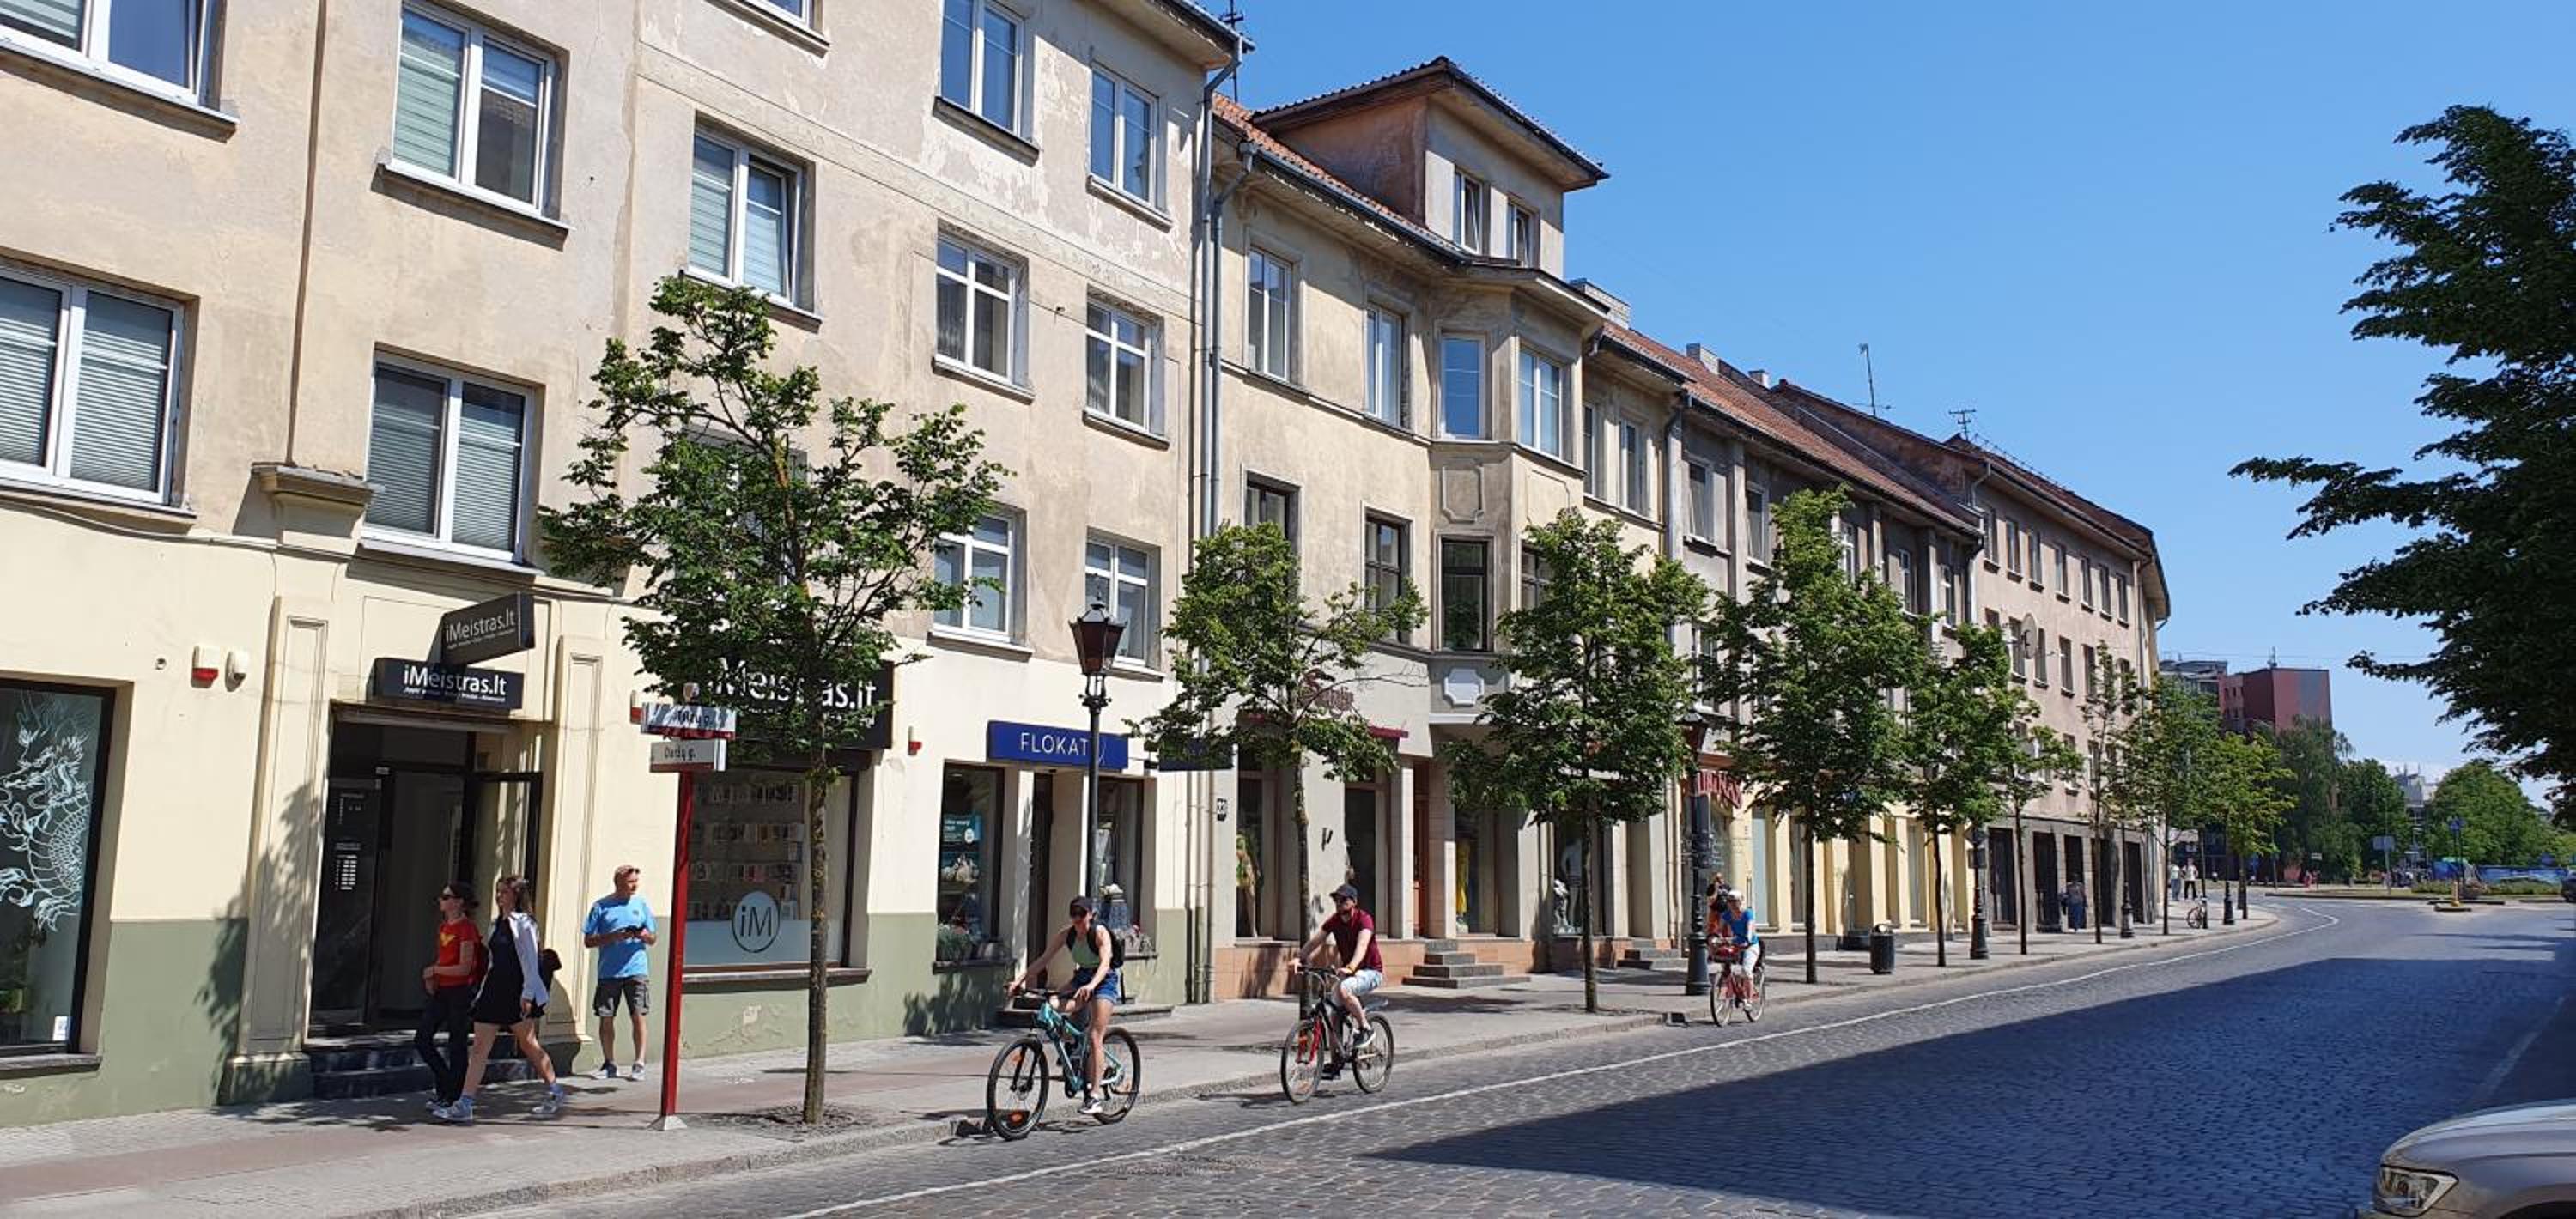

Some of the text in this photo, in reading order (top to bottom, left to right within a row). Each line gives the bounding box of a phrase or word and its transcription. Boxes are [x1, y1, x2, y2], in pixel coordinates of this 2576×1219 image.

[446, 607, 516, 644] iMeistras.lt
[403, 664, 507, 695] iMeistras.lt
[1019, 731, 1094, 757] FLOKAT
[740, 906, 772, 937] iM
